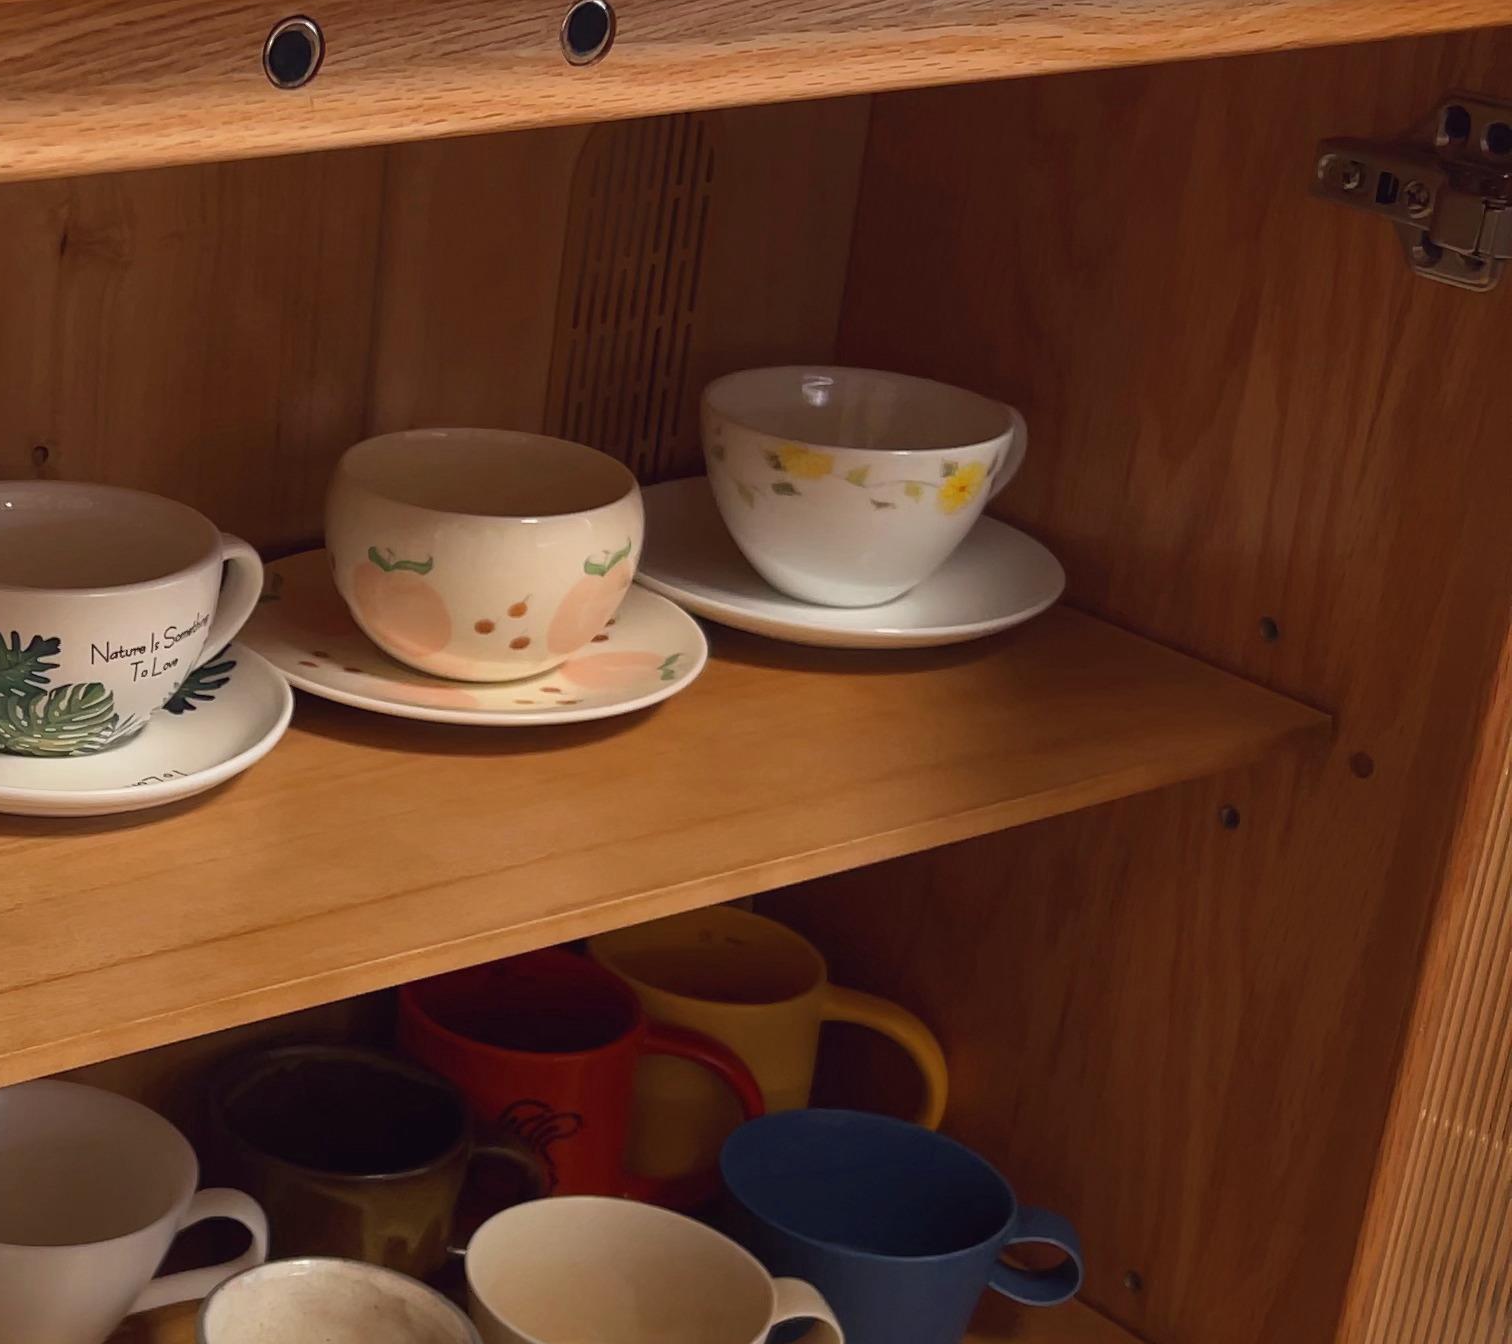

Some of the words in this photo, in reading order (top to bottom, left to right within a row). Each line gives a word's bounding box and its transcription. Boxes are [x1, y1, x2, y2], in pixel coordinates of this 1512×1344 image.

[91, 641, 146, 665] Nature
[150, 632, 160, 654] Is
[131, 660, 149, 683] To
[151, 657, 179, 677] Love
